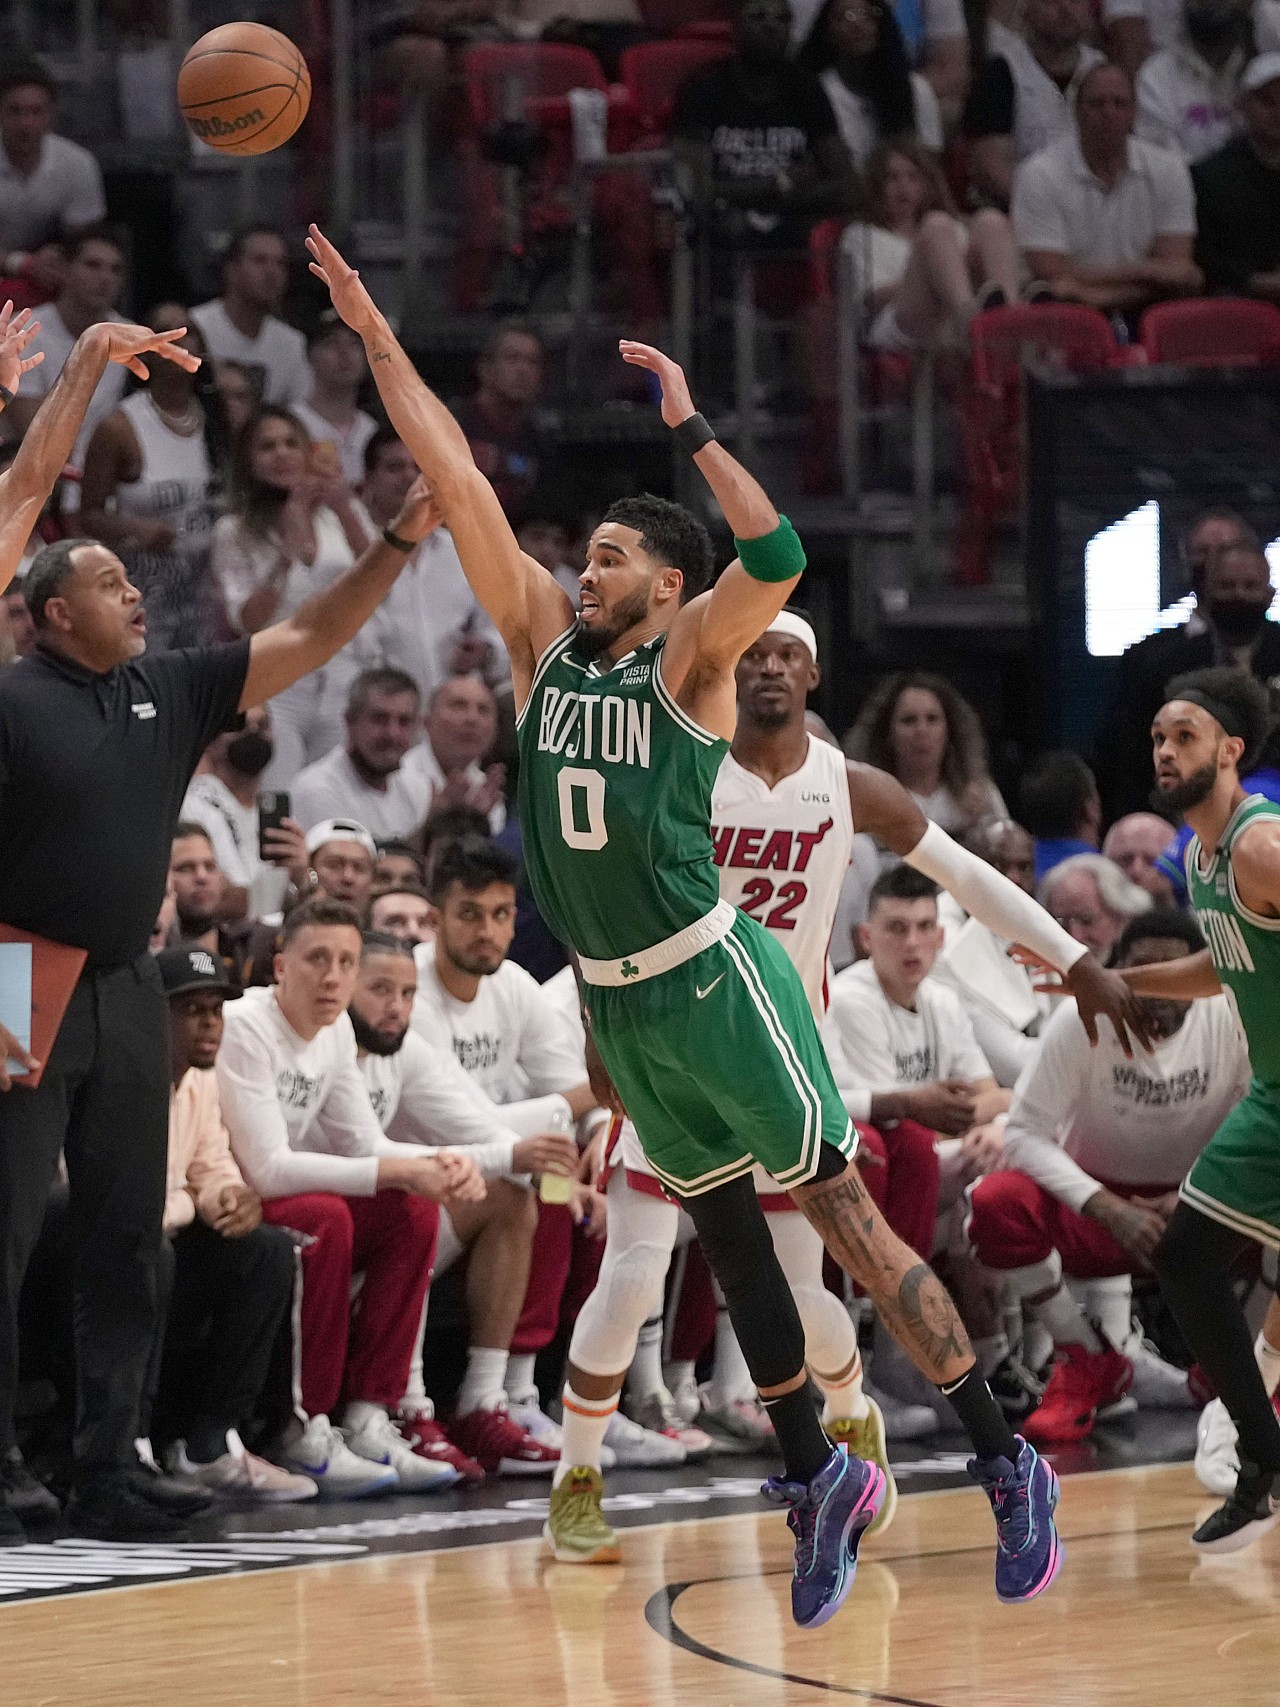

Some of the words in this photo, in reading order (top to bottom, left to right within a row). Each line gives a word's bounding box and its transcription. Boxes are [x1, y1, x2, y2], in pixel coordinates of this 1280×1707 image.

[620, 675, 649, 686] PRINT
[623, 664, 650, 678] VISTA
[557, 766, 609, 851] 0
[801, 791, 831, 803] UKG
[710, 815, 834, 873] HEAT
[737, 876, 808, 930] 22
